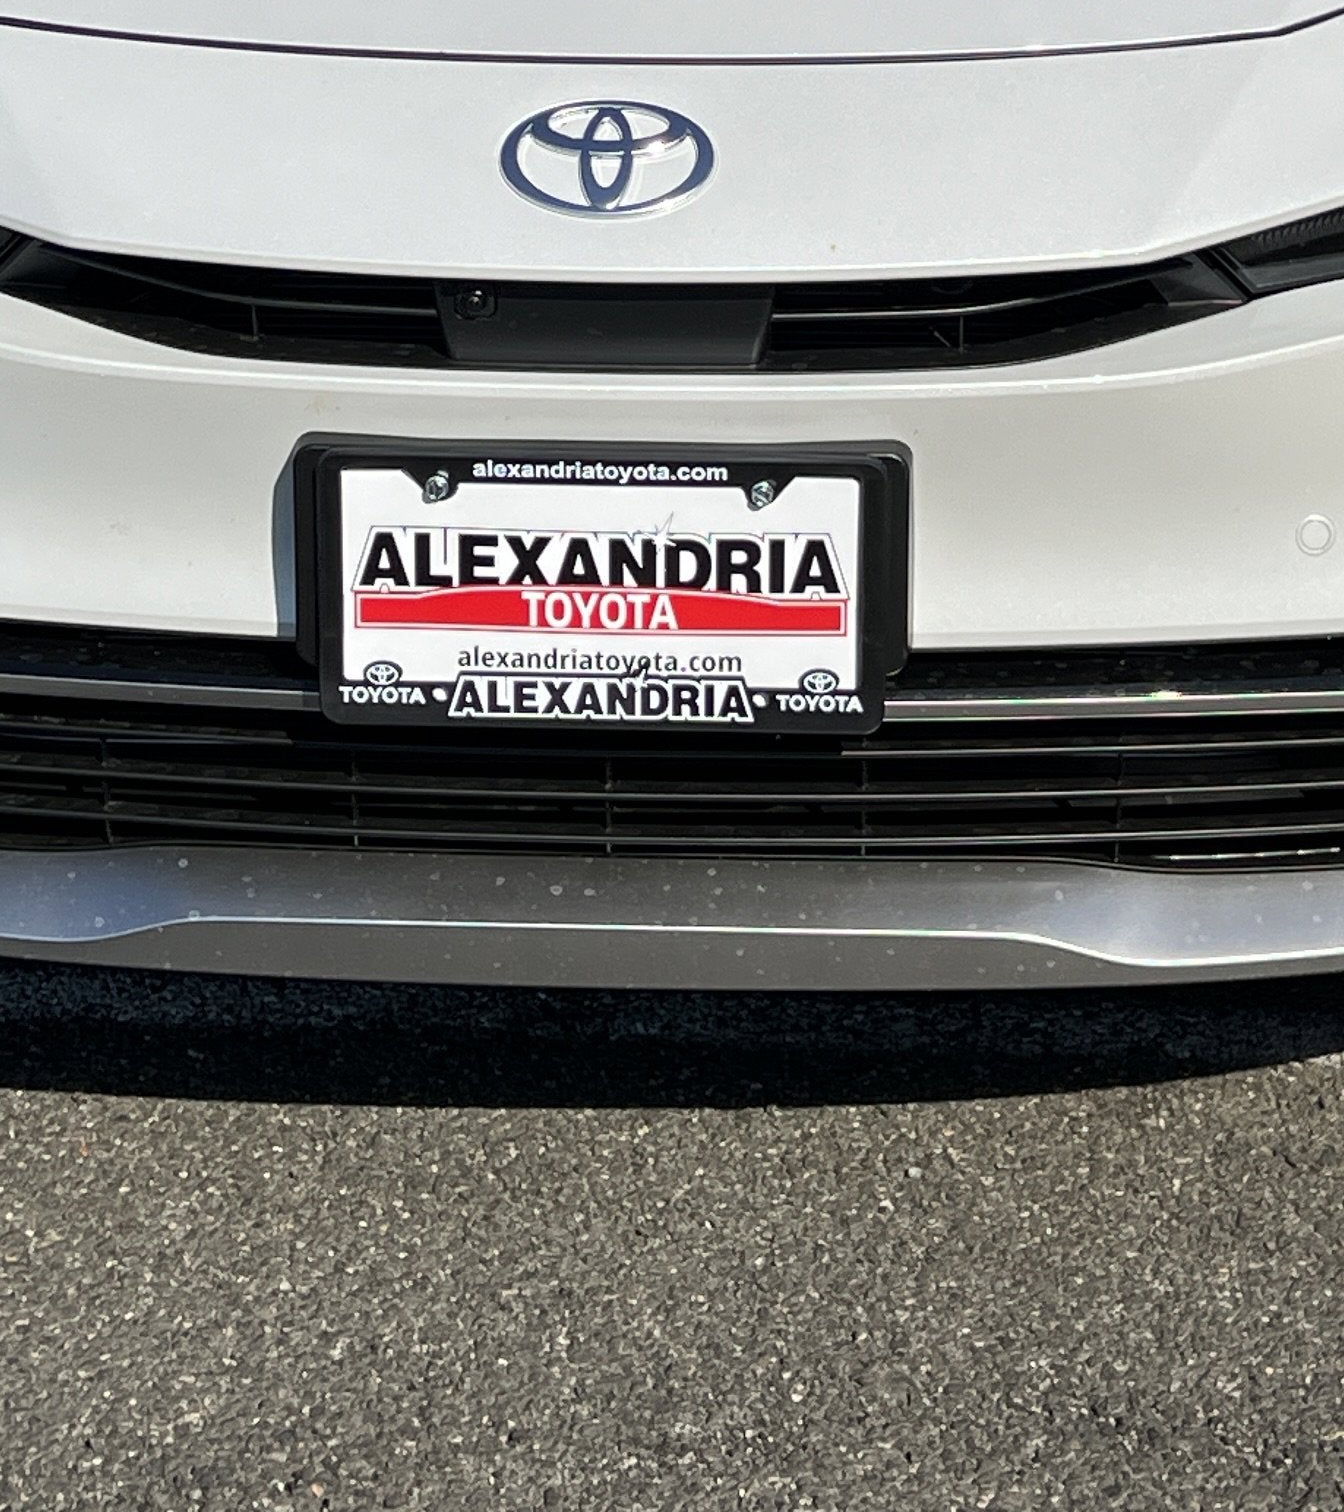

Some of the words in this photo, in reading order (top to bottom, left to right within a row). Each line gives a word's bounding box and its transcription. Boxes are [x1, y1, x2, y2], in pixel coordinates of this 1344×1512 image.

[472, 459, 729, 484] alexandriatoyota.com
[359, 531, 841, 595] ALEXANDRIA
[521, 590, 679, 630] TOYOTA
[457, 645, 743, 674] alexandriatoyota.com
[340, 687, 425, 705] TOYOTA
[452, 678, 752, 720] ALEXANDRIA
[776, 694, 863, 714] TOYOTA
